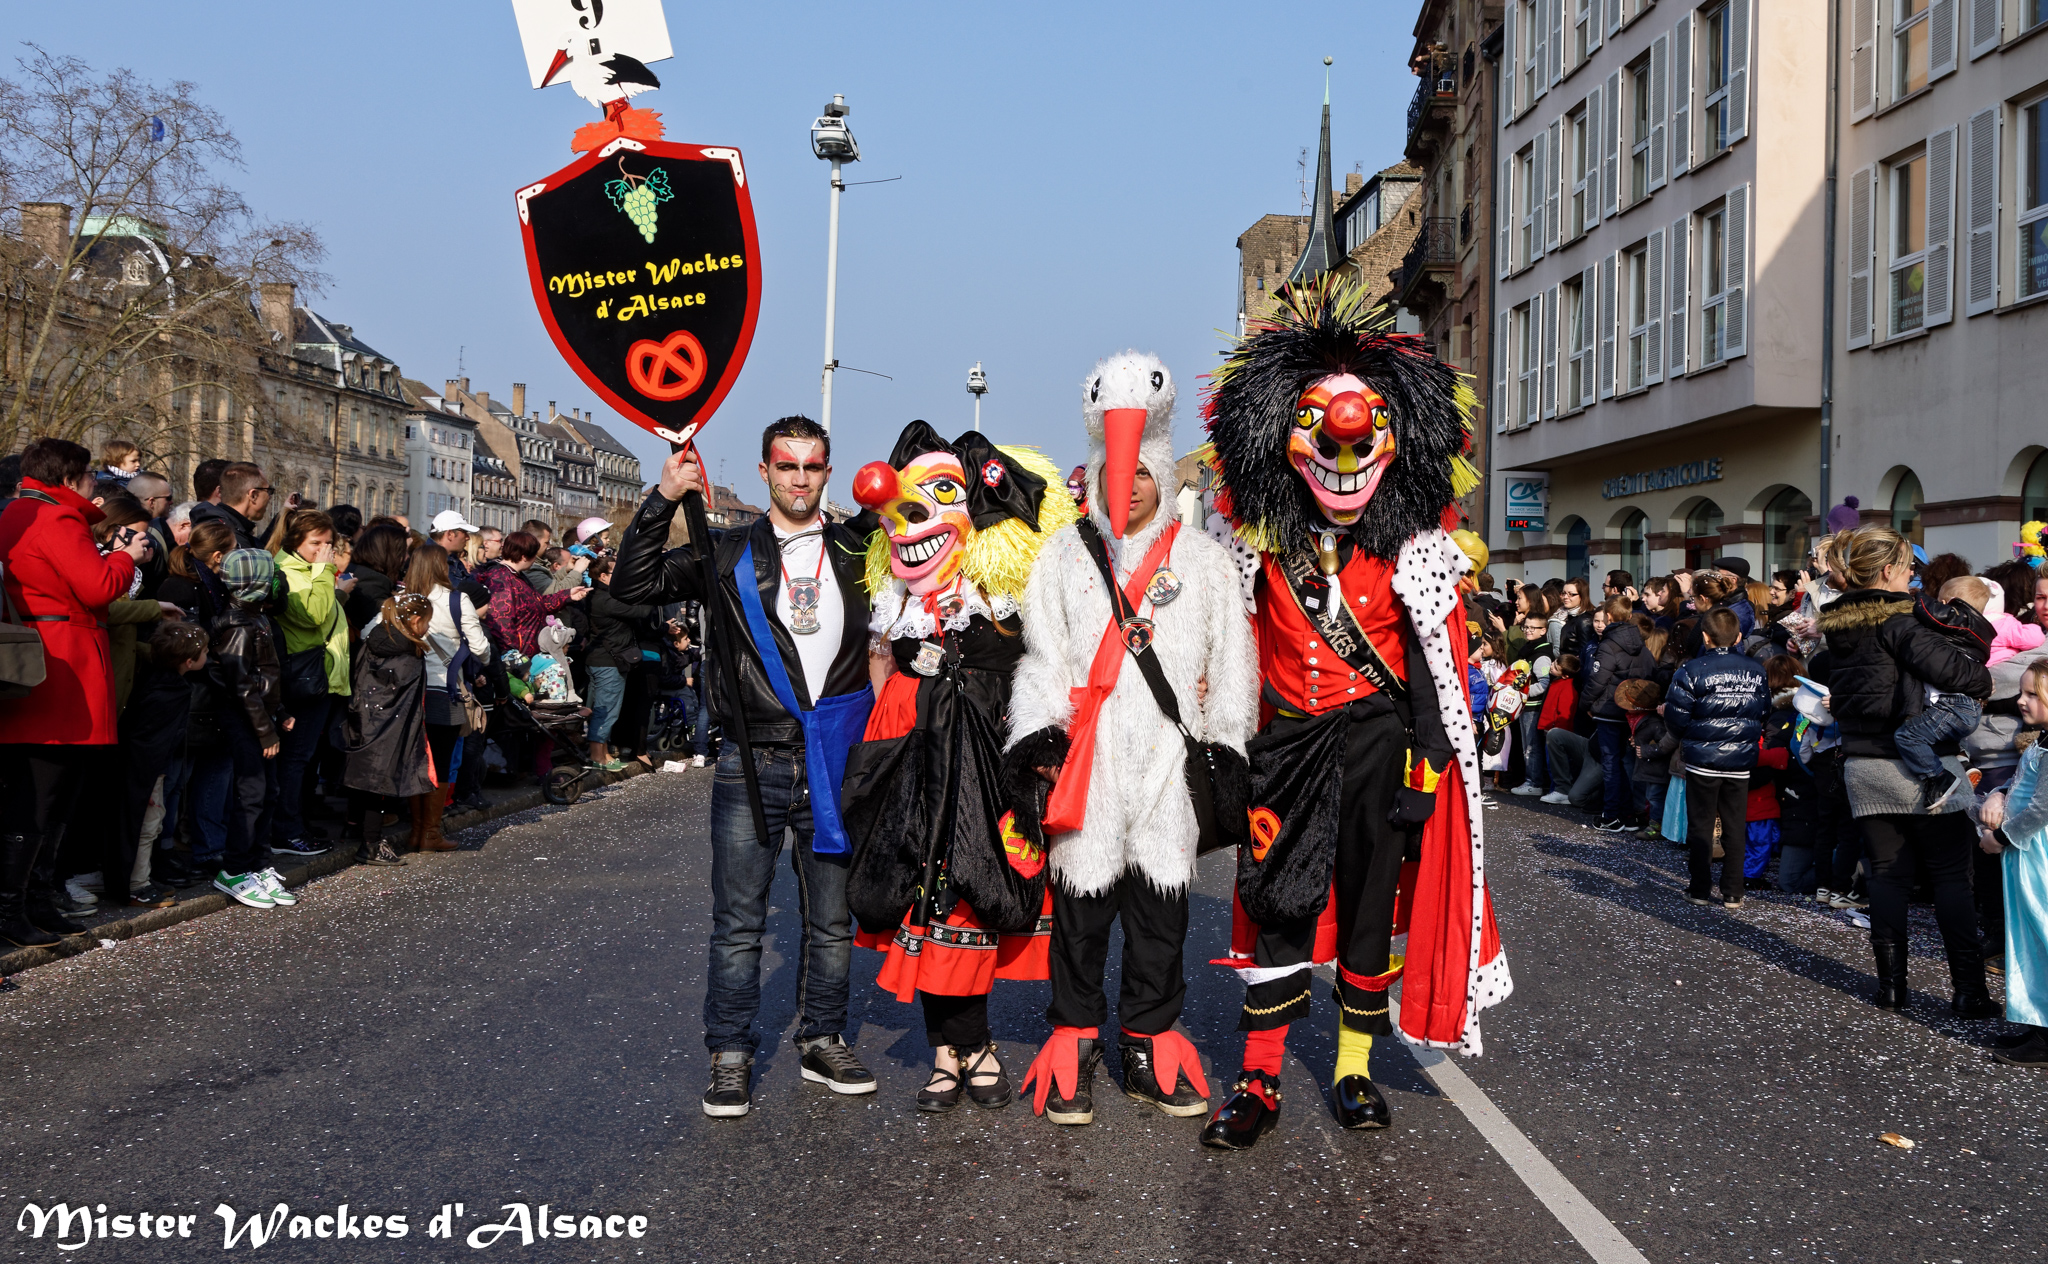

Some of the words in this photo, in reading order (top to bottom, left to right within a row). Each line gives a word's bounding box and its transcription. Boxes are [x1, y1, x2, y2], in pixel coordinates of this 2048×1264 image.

[549, 269, 637, 298] Mister
[645, 253, 744, 286] Wackes
[1903, 307, 1912, 317] DU
[1646, 457, 1723, 490] AGRICOLE
